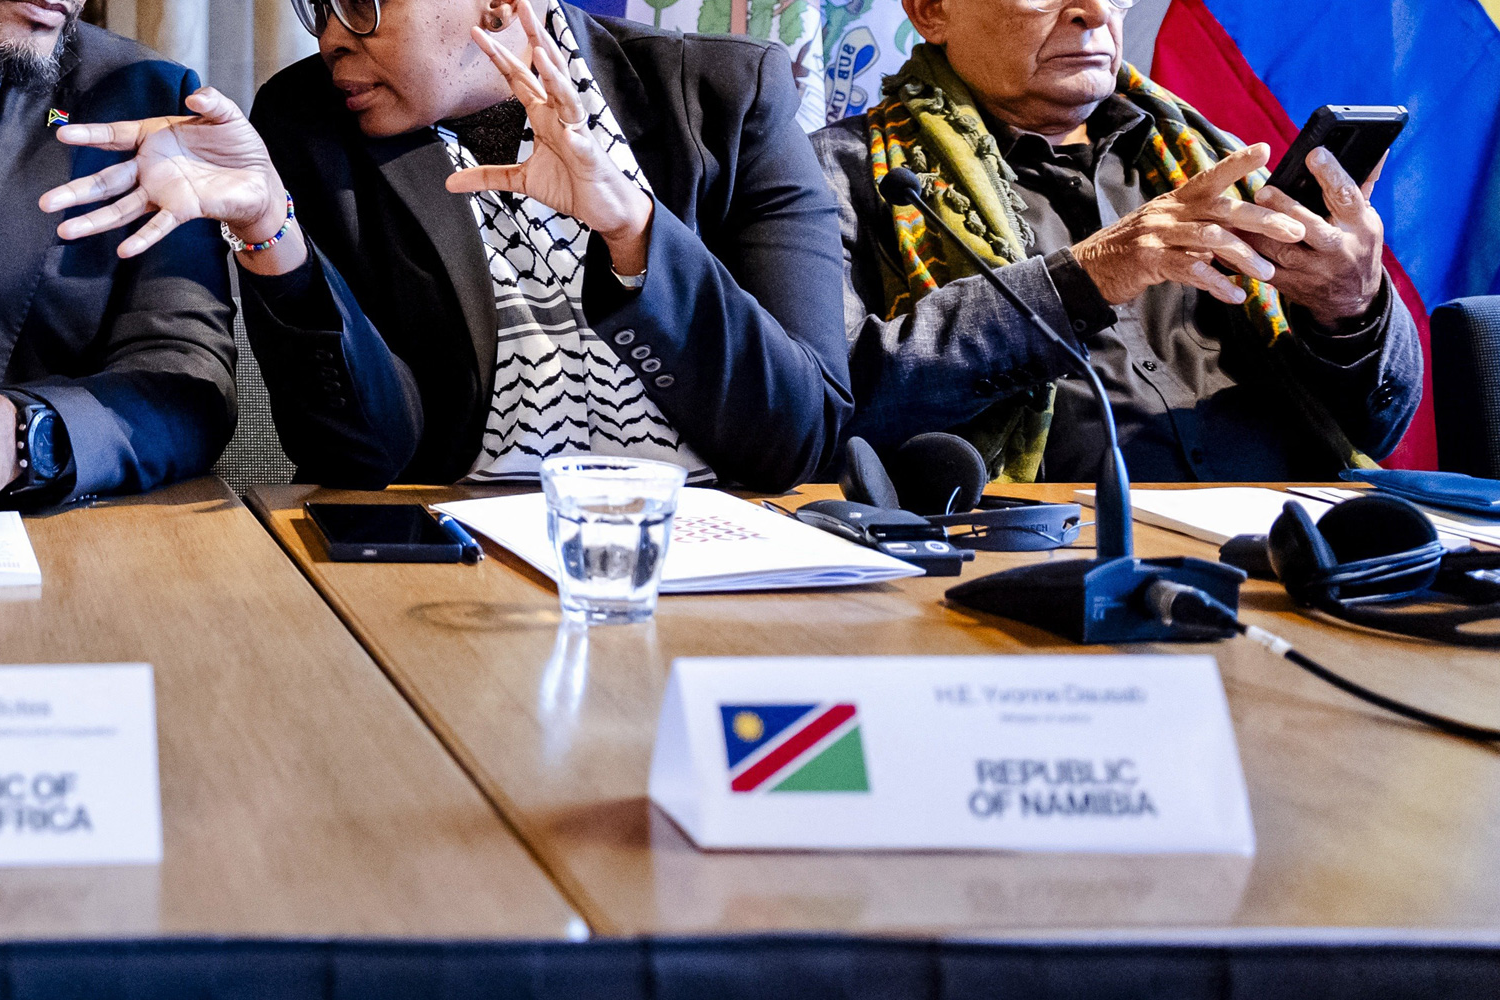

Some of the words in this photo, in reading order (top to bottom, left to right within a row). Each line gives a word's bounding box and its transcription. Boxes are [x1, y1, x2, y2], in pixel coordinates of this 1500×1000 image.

[31, 771, 79, 802] OF
[973, 757, 1139, 787] REPUBLIC
[967, 787, 1010, 818] OF
[1019, 789, 1160, 818] NAMIBIA
